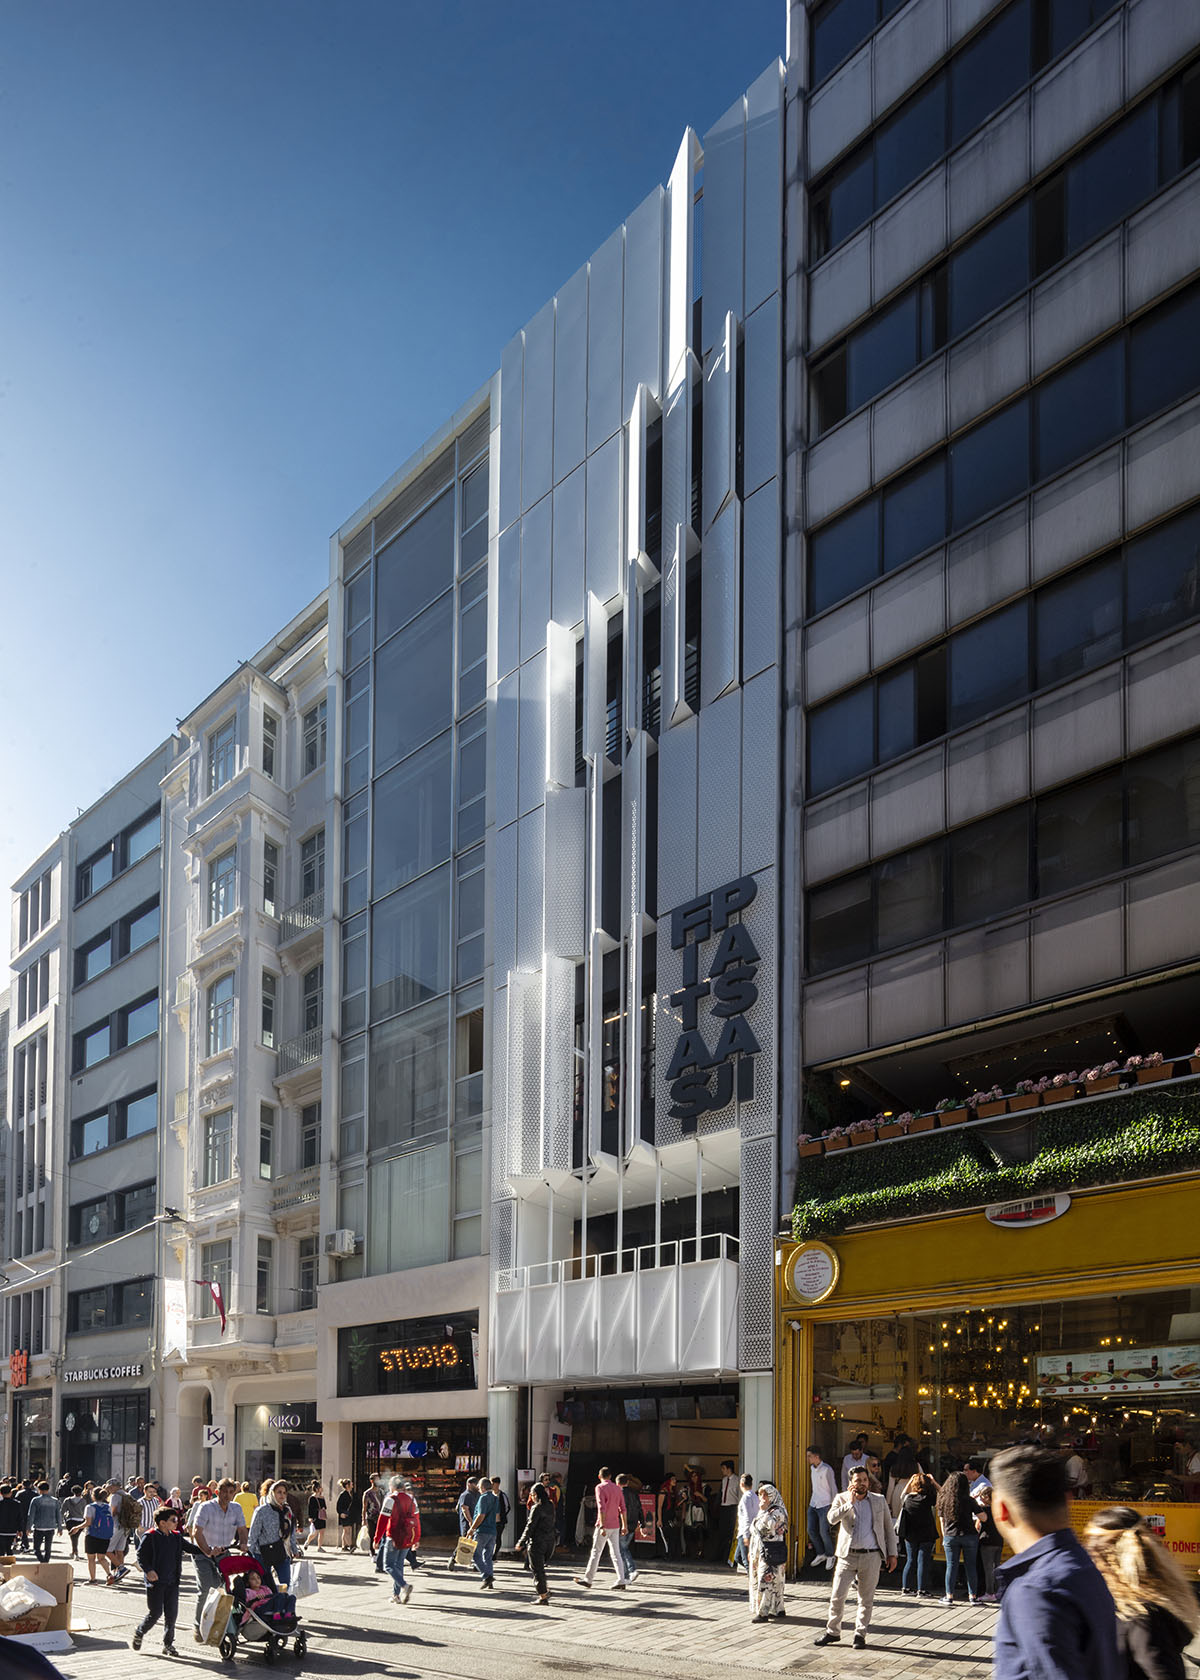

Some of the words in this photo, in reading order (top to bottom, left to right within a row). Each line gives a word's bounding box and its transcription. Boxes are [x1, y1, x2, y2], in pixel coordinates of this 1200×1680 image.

[380, 1344, 458, 1371] STUDIO
[64, 1368, 109, 1382] STARBUCKS
[110, 1365, 142, 1378] COFFEE
[268, 1414, 301, 1428] KIKO
